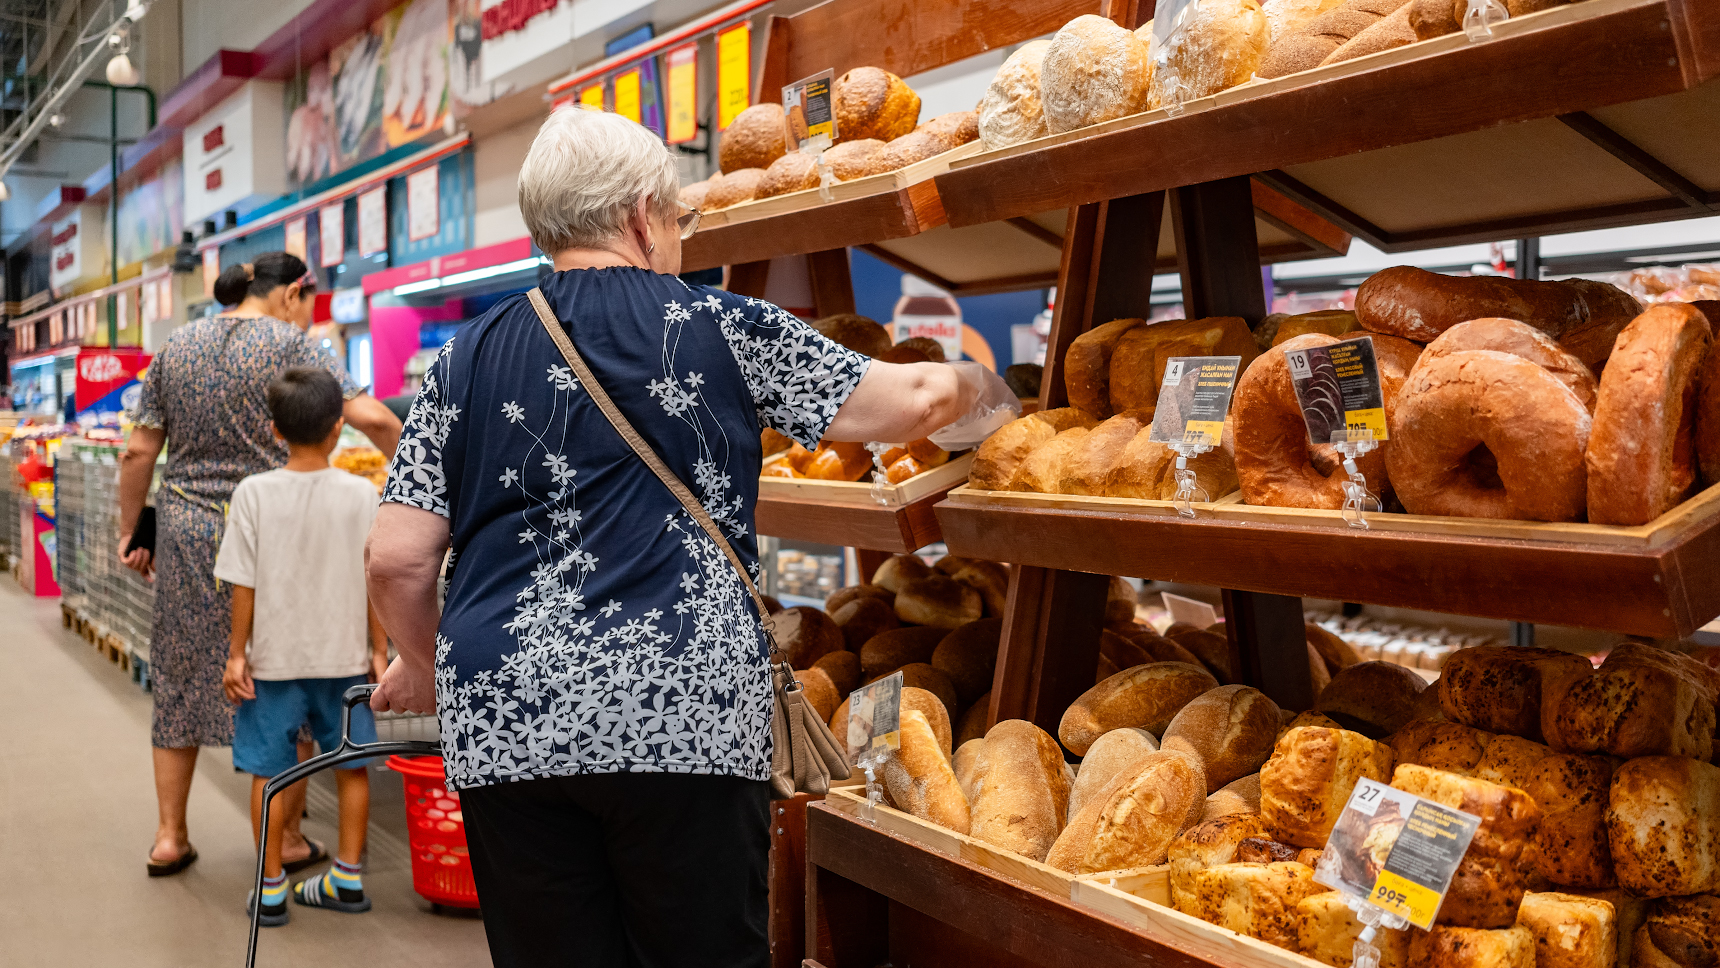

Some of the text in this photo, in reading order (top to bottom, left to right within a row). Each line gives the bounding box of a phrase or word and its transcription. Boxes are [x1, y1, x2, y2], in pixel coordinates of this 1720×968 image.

[1290, 355, 1305, 370] 19
[1172, 364, 1179, 377] 4
[852, 694, 860, 707] 23
[1358, 785, 1381, 802] 27
